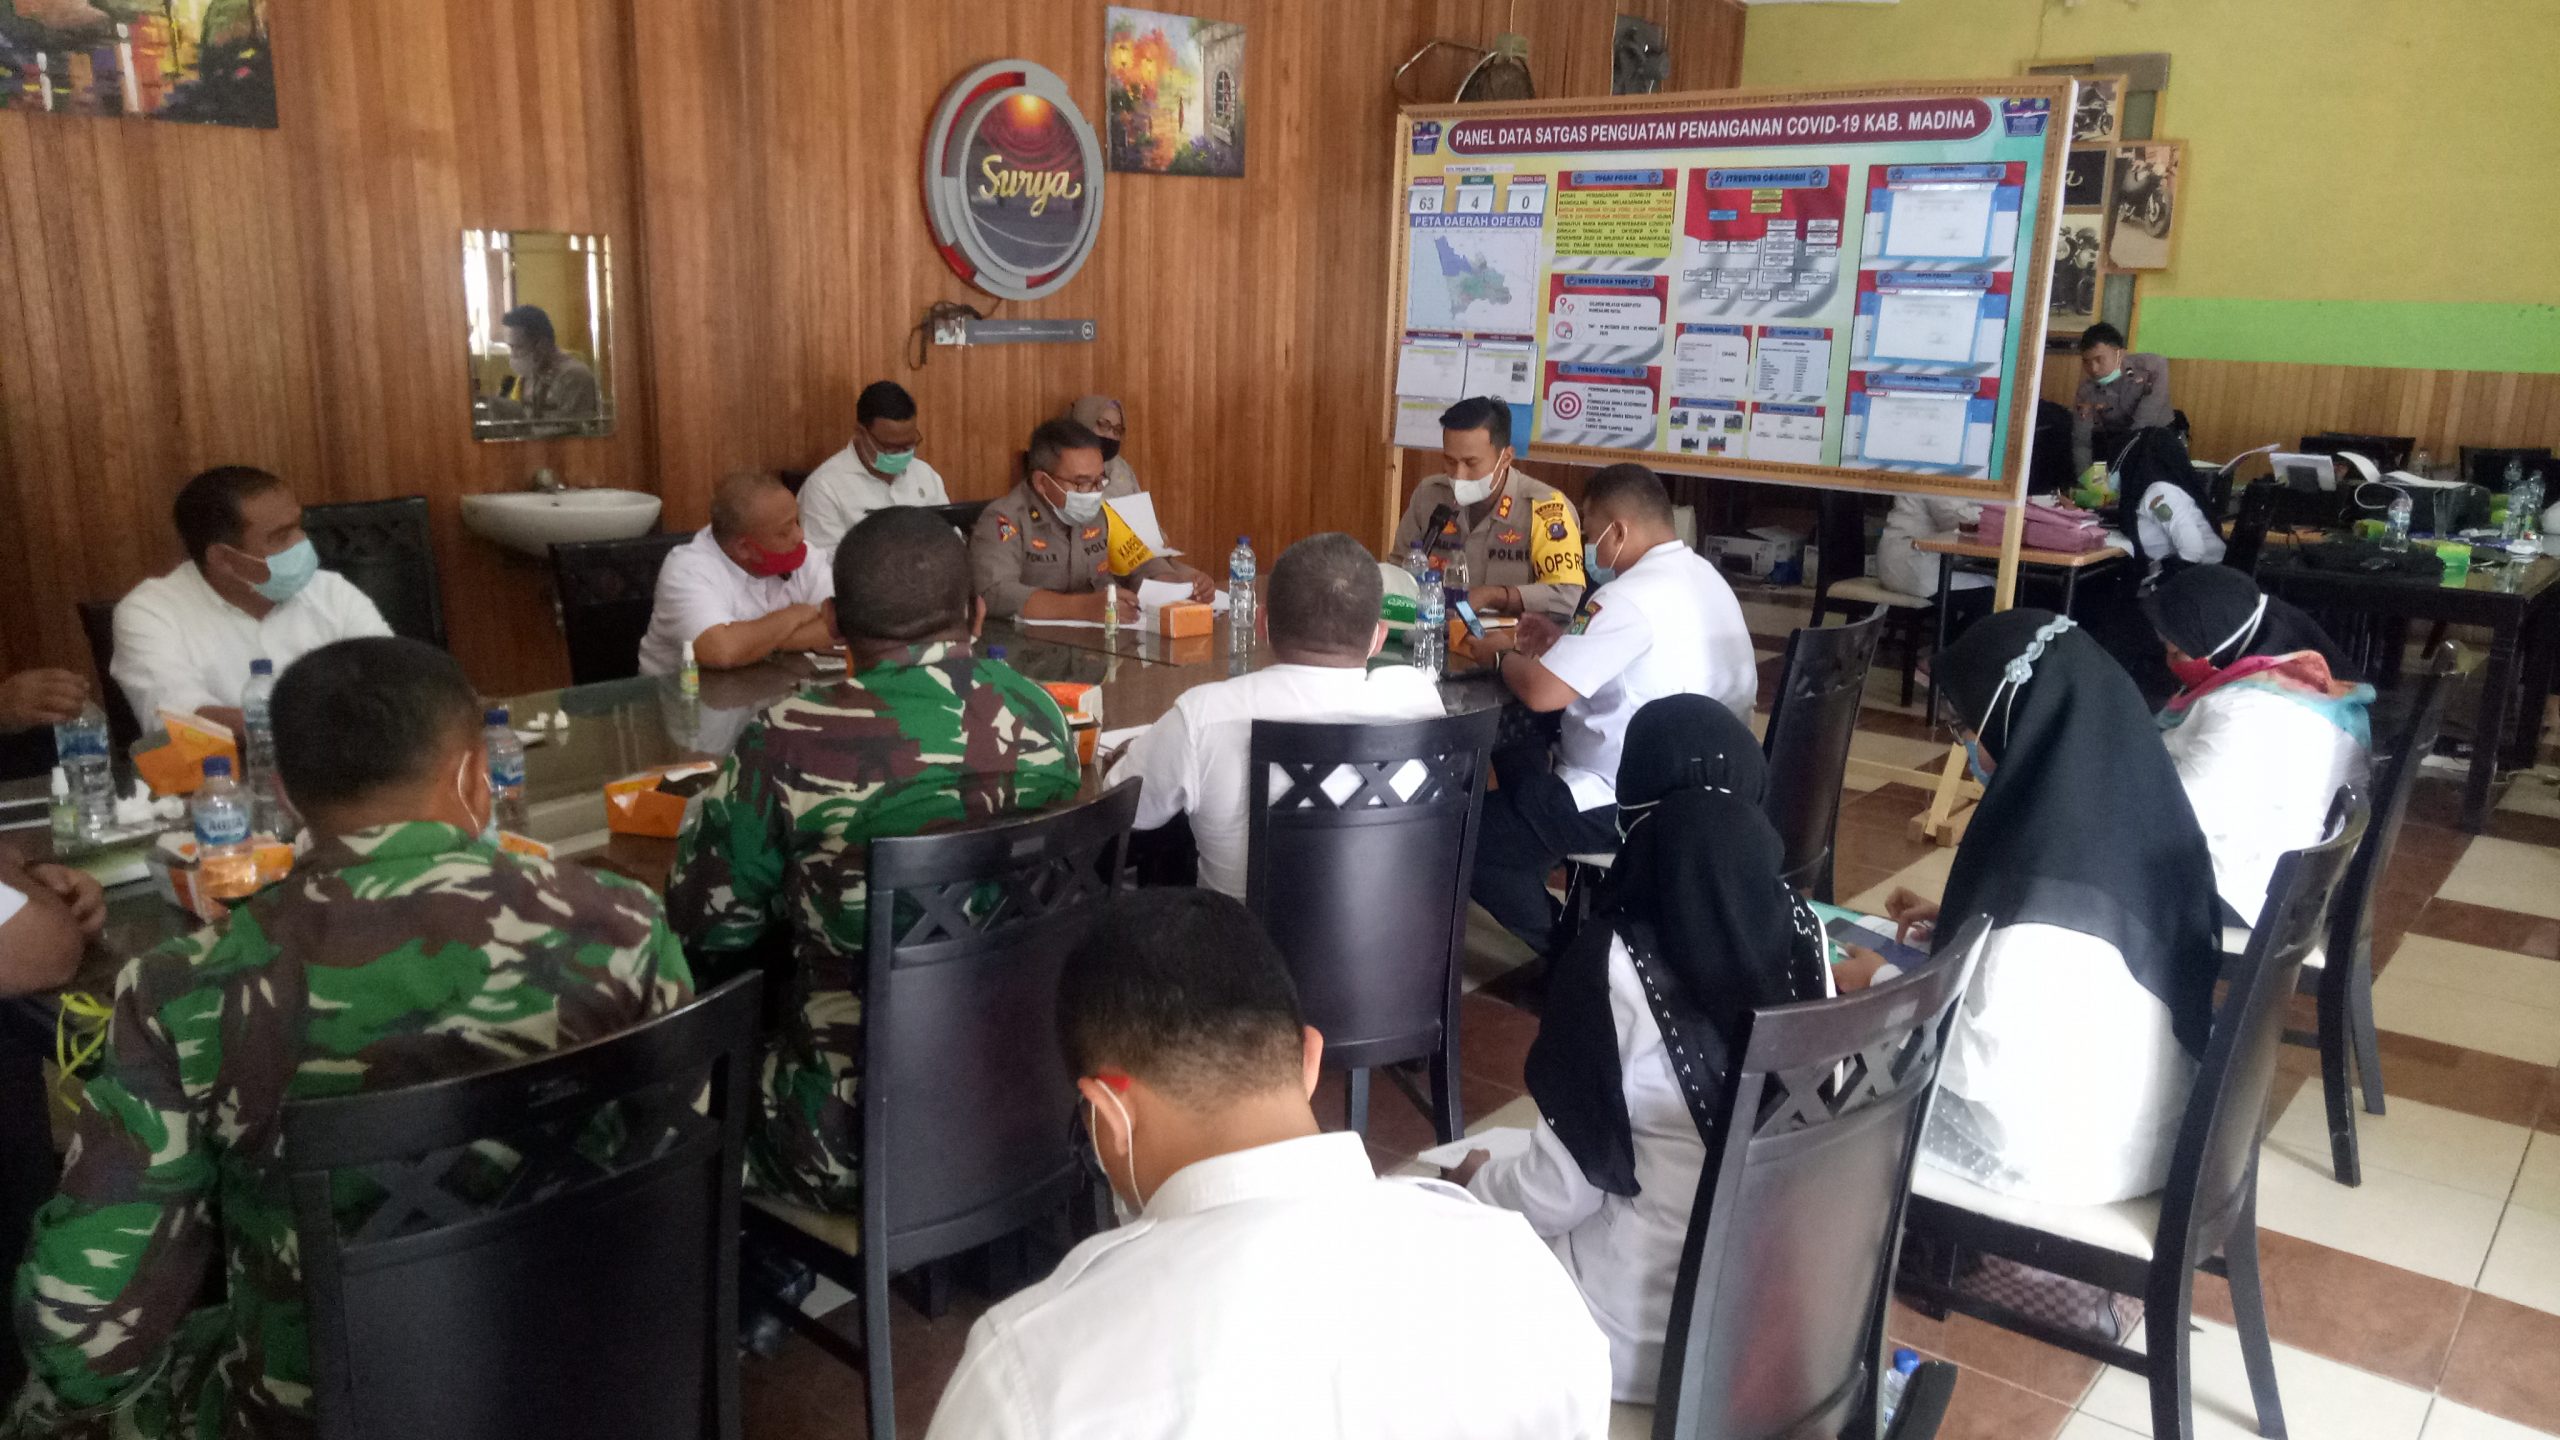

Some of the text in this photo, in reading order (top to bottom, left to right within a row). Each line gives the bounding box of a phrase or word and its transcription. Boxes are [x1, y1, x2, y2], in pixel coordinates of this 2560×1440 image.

[1455, 109, 1976, 146] PANEL DATA SATGAS PENGUATAN PENANGANAN COVID-19 KAB. MADINA
[979, 154, 1082, 217] Surya
[1419, 196, 1434, 211] 63
[1471, 196, 1479, 210] 4
[1522, 196, 1530, 210] 0
[1415, 216, 1540, 227] PETA DAERAH OPERASI
[1545, 551, 1574, 573] OPS
